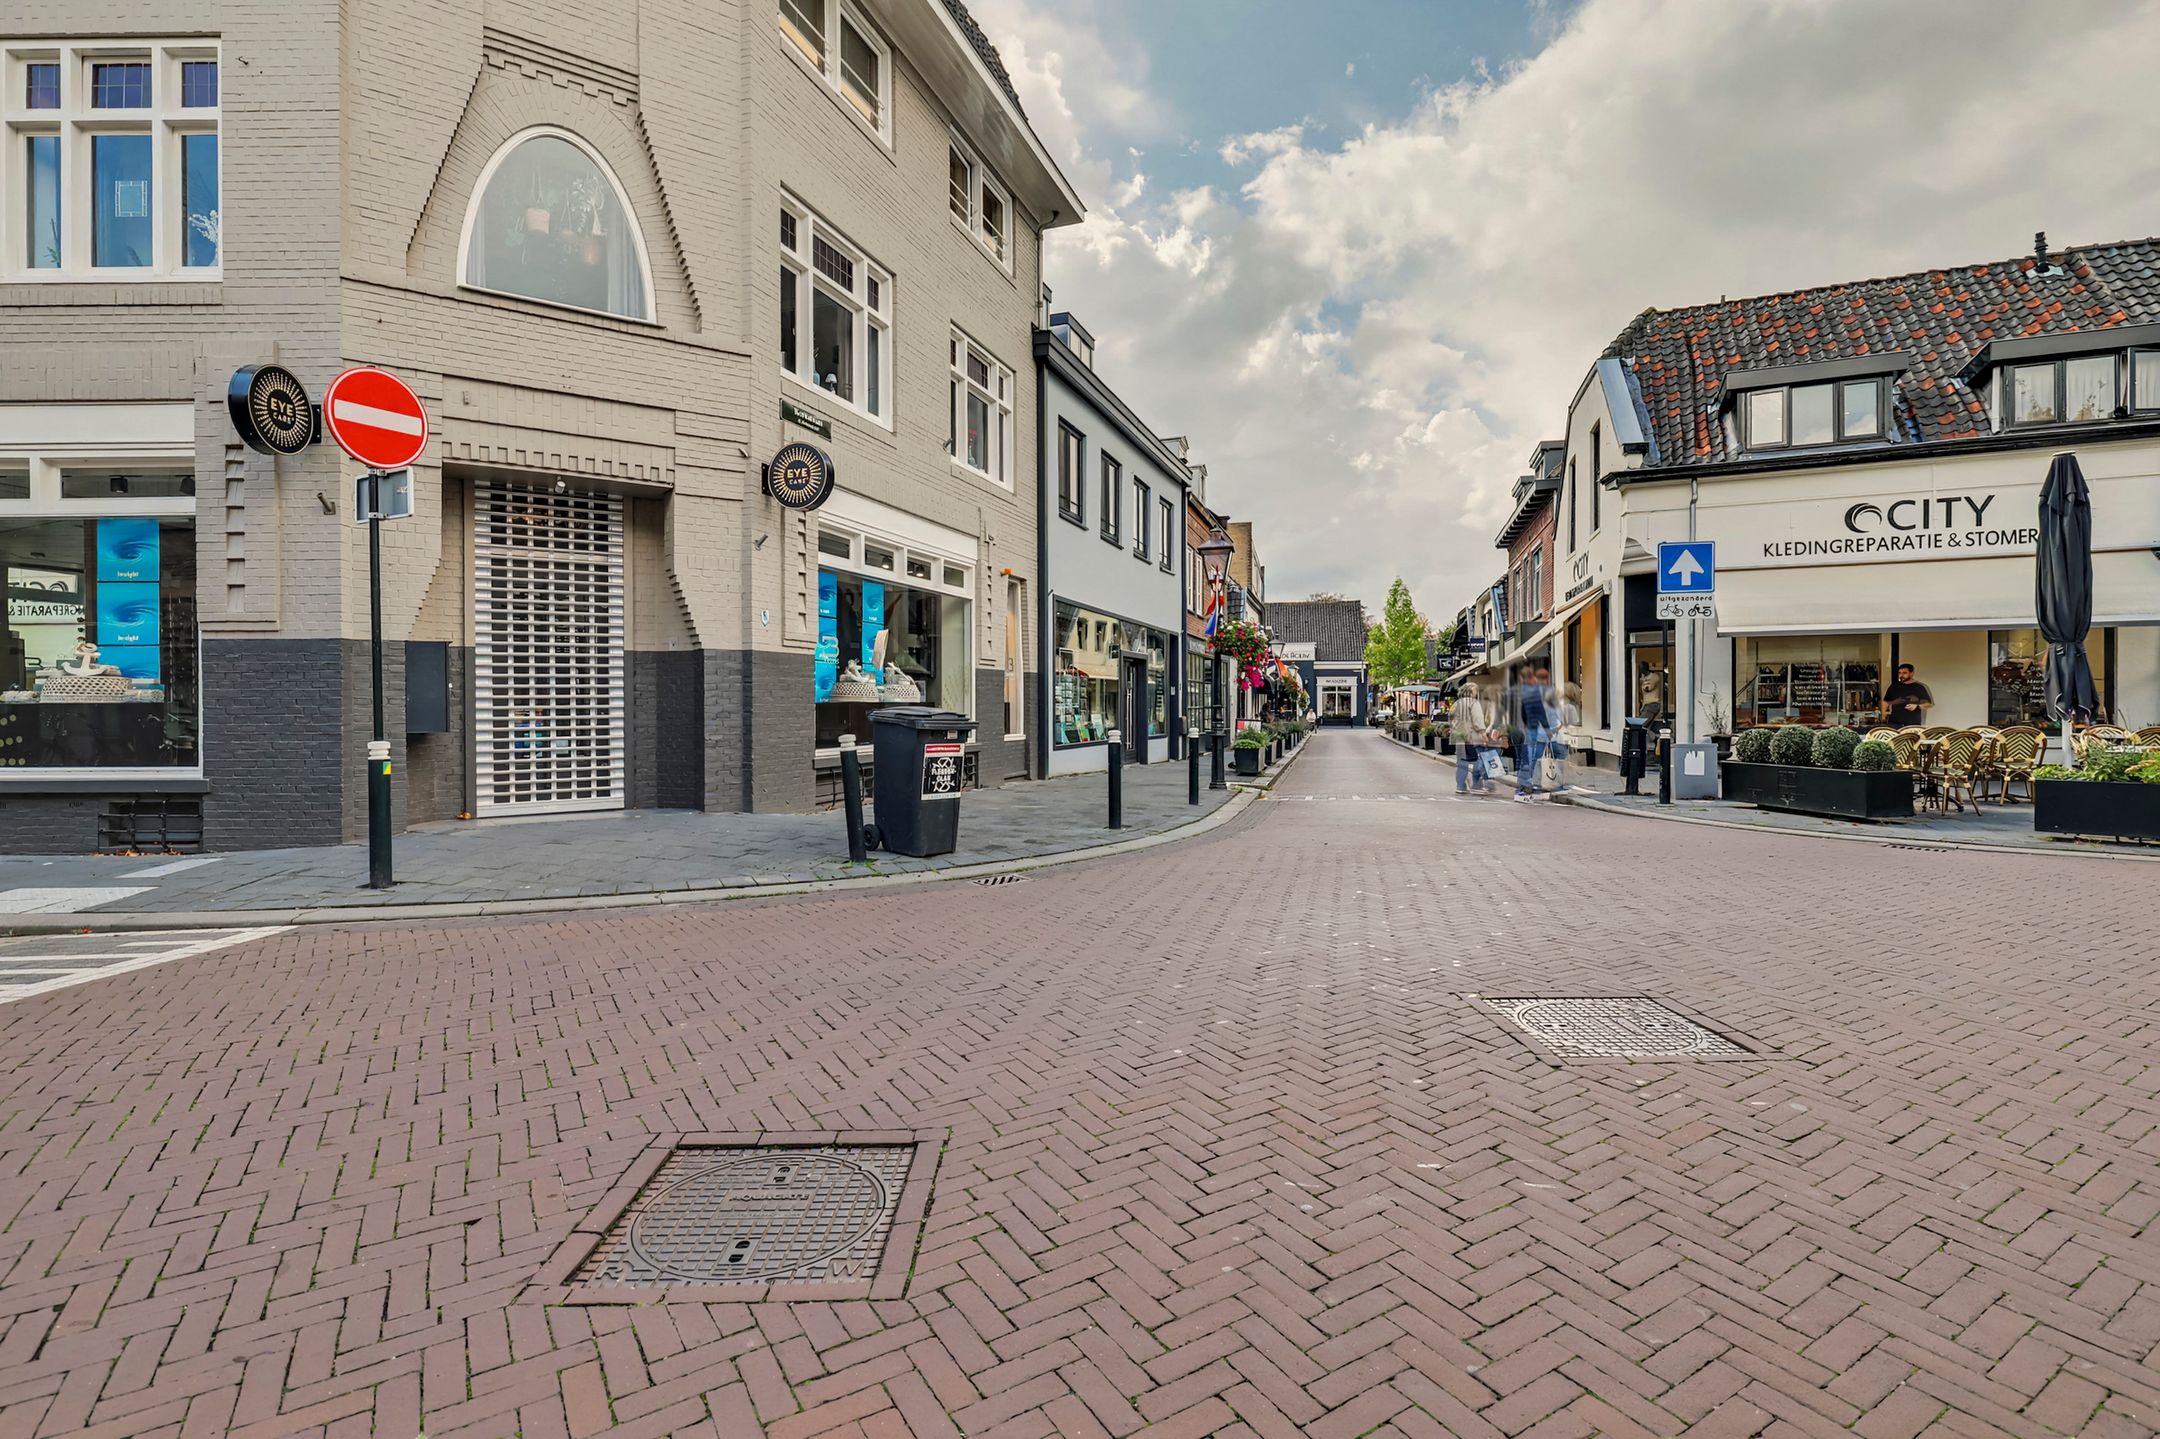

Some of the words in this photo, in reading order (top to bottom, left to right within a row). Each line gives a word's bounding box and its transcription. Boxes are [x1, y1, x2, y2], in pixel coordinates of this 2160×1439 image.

[270, 397, 294, 416] EYE
[787, 467, 808, 479] EYE
[1887, 494, 1996, 531] CITY
[1763, 533, 1943, 558] KLEDINGREPARATIE
[1947, 533, 1962, 547] &
[831, 1260, 863, 1277] W
